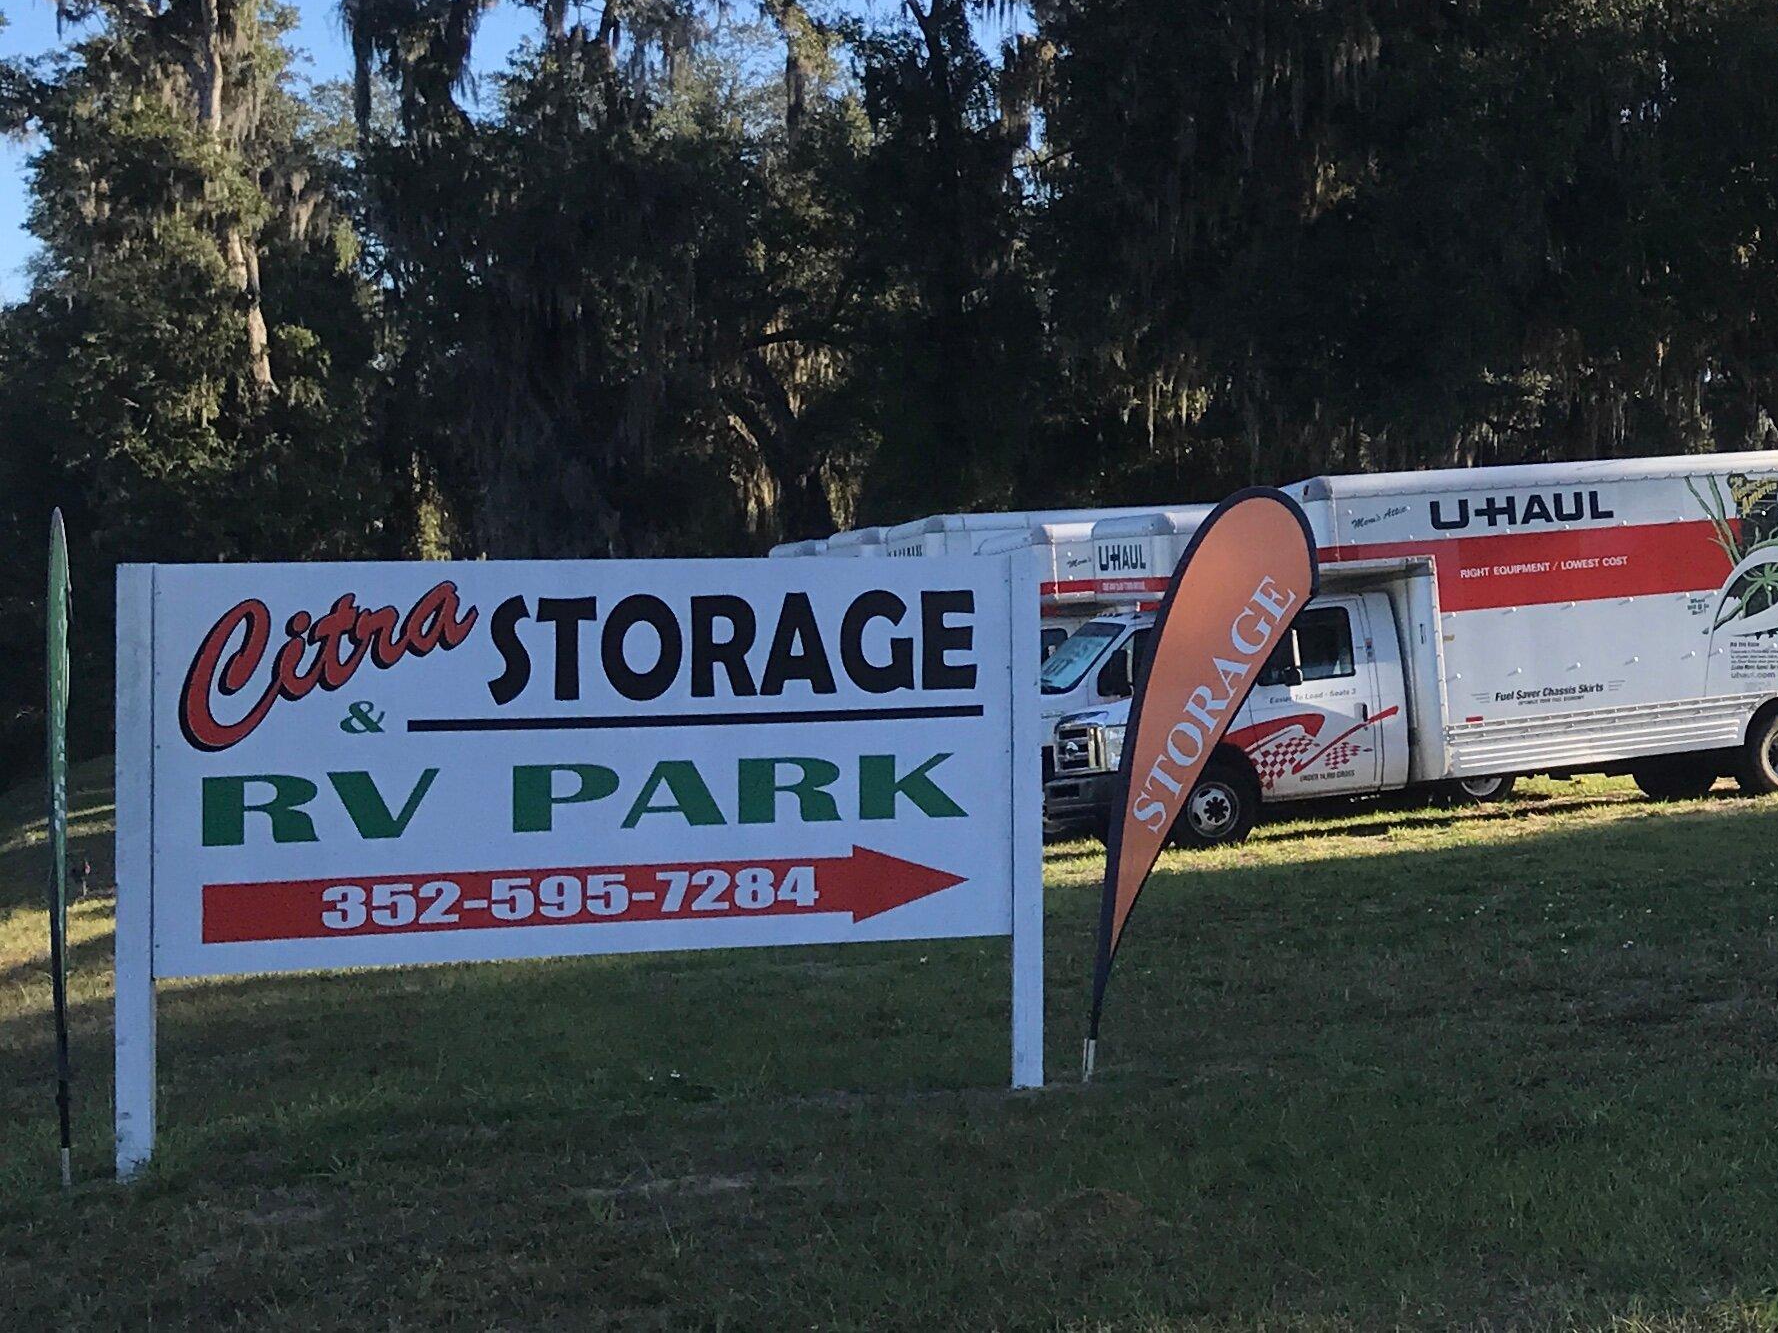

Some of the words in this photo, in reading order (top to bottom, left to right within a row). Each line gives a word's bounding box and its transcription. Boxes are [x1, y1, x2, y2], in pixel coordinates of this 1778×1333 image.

[1429, 490, 1614, 531] U-HAUL
[1098, 544, 1146, 571] U-HAUL
[1460, 567, 1490, 578] RIGHT
[1493, 562, 1550, 576] EQUIPMENT
[1560, 558, 1600, 570] LOWEST
[1602, 556, 1628, 566] COST
[178, 579, 478, 753] Citra
[488, 589, 978, 705] STORAGE
[1132, 575, 1297, 834] STORAGE
[1495, 691, 1515, 702] Fuel
[1516, 689, 1541, 701] Saver
[1542, 685, 1577, 698] Chassis
[1578, 682, 1604, 694] Skirts
[339, 699, 386, 735] &
[202, 767, 440, 847] RV
[512, 751, 969, 833] PARK
[321, 865, 820, 930] 352-595-7284
